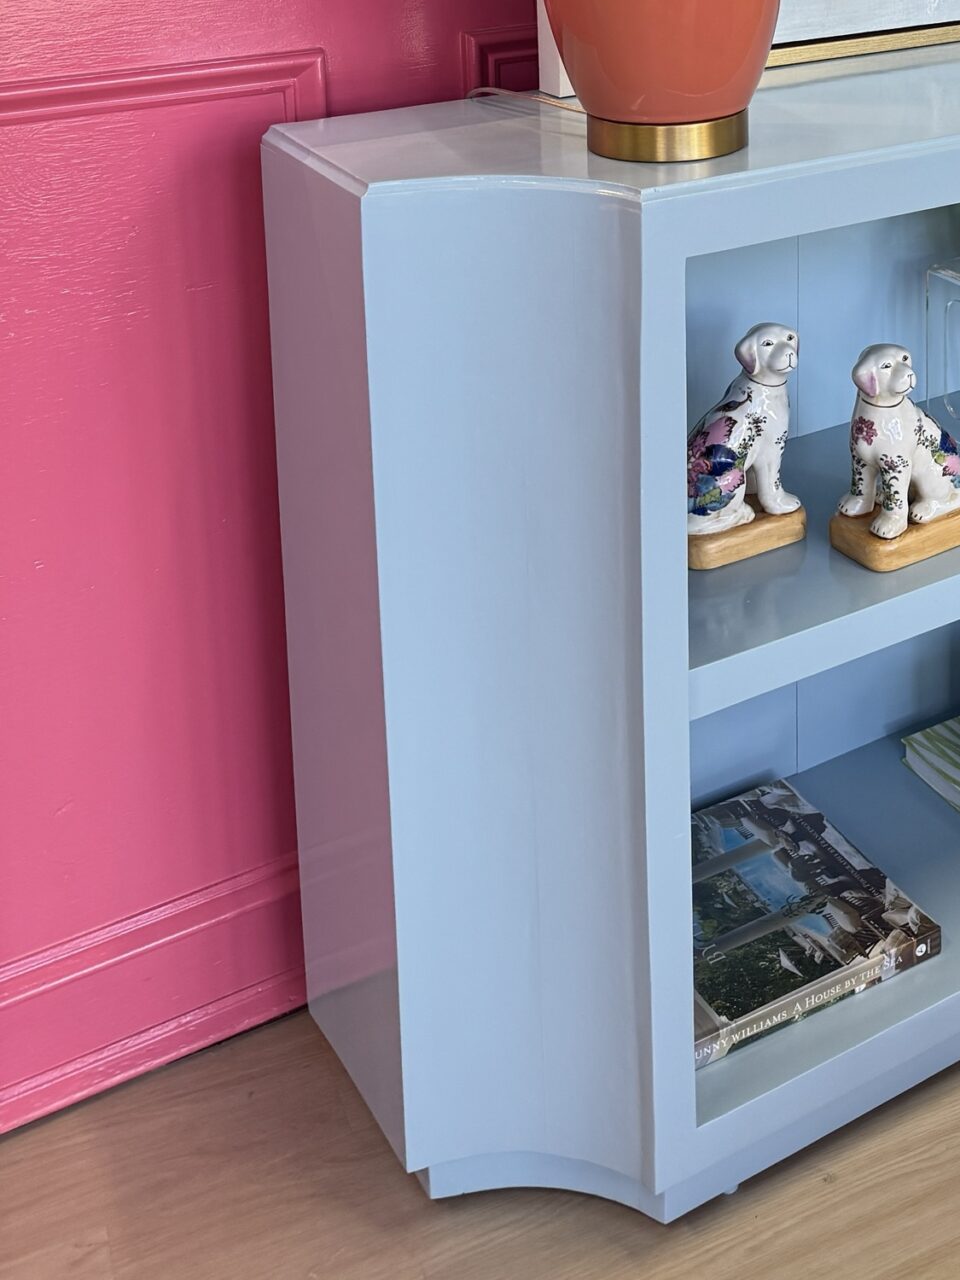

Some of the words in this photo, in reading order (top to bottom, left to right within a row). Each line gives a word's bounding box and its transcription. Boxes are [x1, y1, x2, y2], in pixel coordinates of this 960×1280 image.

[695, 1036, 730, 1060] UNNY
[731, 1009, 788, 1043] WILLIAMS
[791, 1001, 803, 1016] A
[804, 983, 842, 1009] HOUSE
[844, 976, 858, 992] BY
[858, 966, 882, 983] THE
[882, 951, 904, 971] SEA
